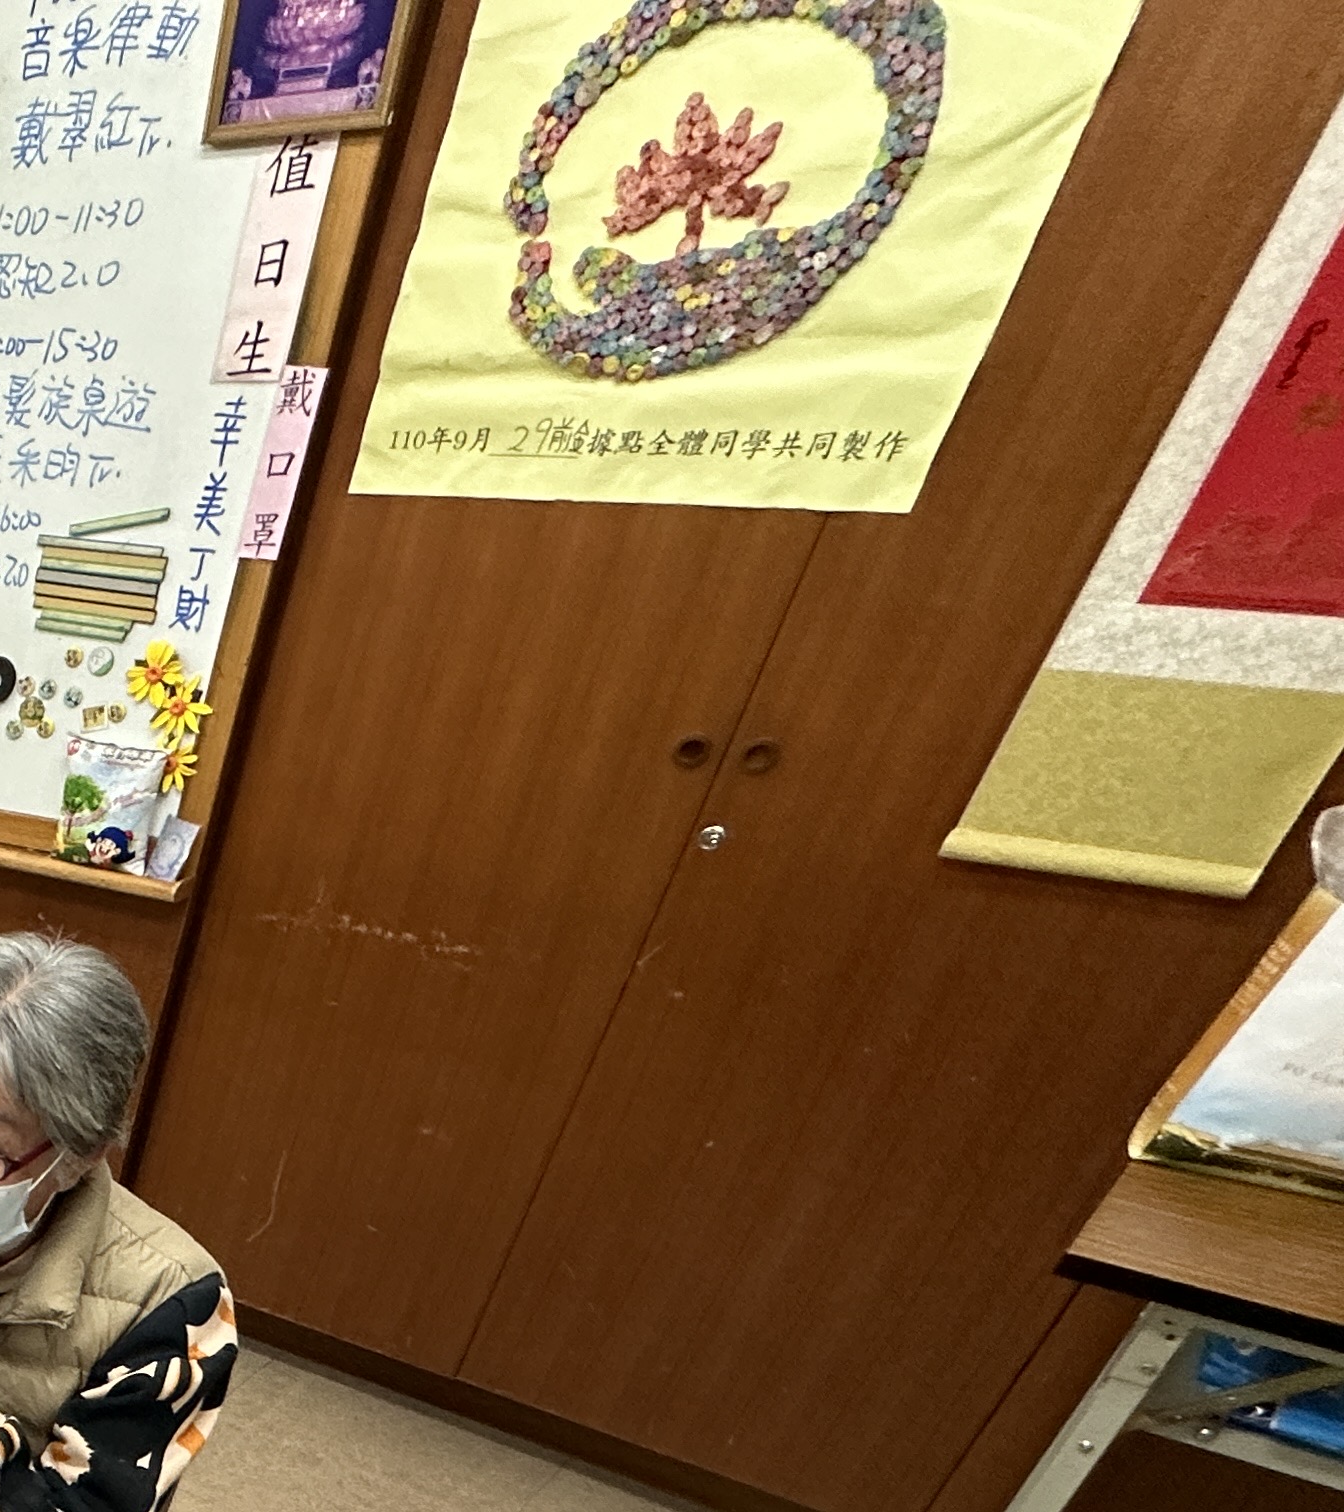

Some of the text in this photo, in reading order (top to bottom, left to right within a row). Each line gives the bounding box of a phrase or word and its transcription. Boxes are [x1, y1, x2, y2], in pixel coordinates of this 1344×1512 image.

[226, 133, 319, 377] 值日生
[243, 368, 315, 558] 戴口罩
